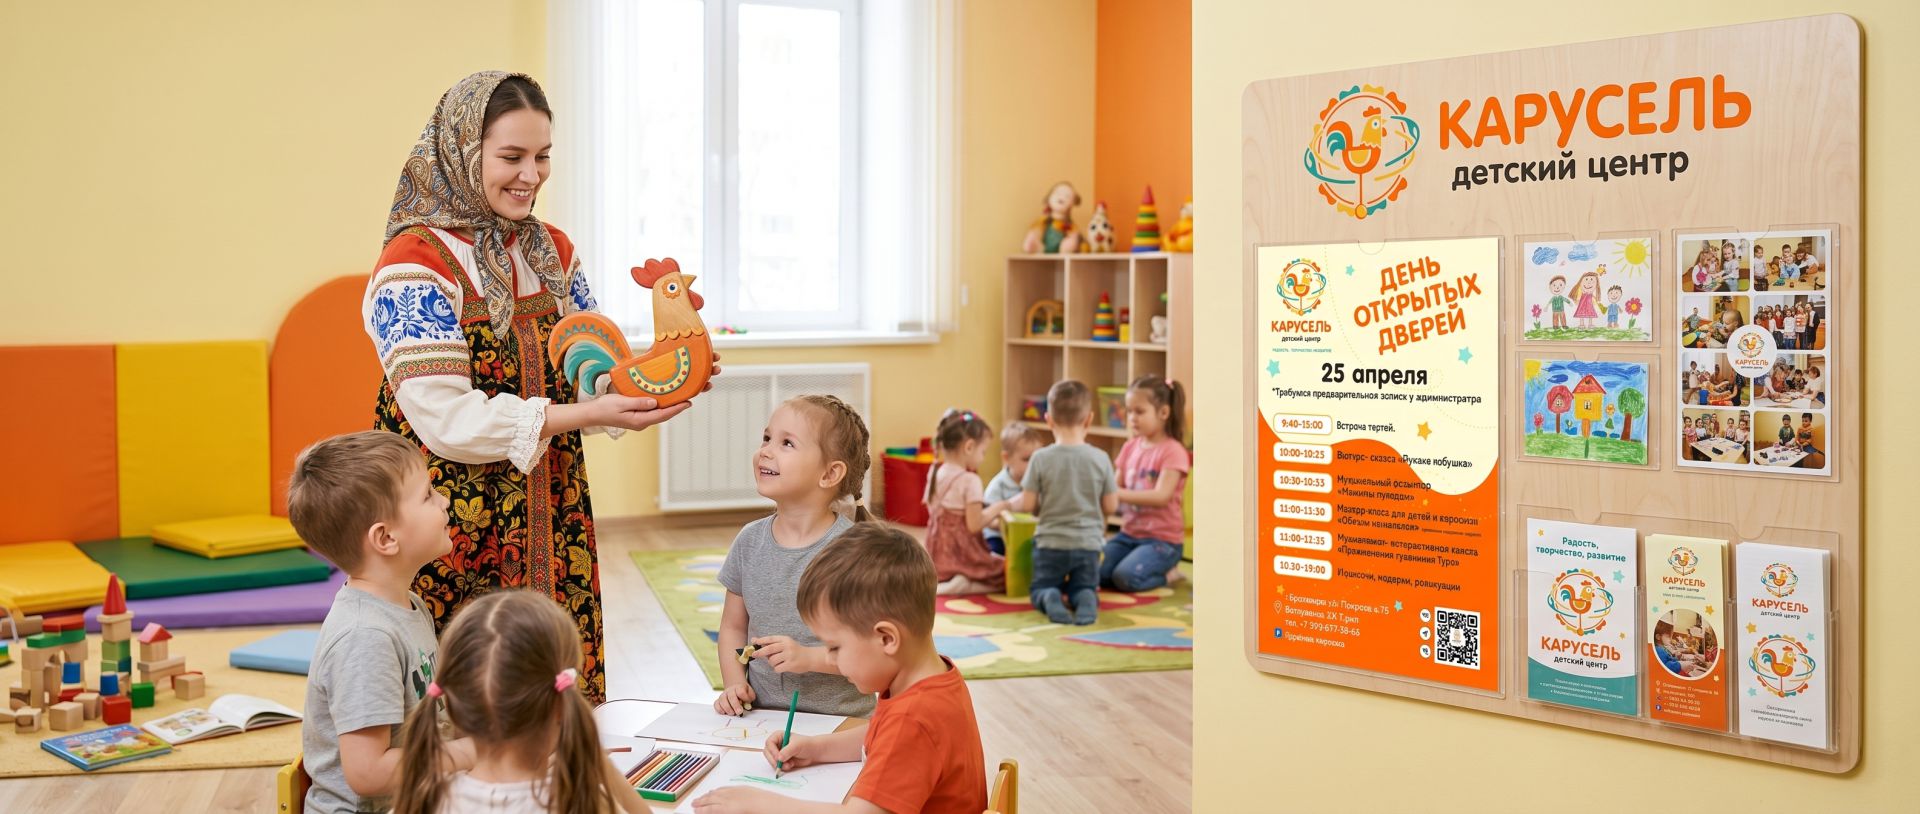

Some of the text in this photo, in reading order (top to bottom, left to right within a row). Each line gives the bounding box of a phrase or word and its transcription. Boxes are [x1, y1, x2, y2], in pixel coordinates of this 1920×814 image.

[1439, 74, 1752, 150] КАРУСЕЛЬ
[1452, 150, 1690, 191] детский центр
[1379, 255, 1441, 295] ДЕНЬ
[1353, 272, 1482, 328] ОТКРЫТЫХ
[1271, 320, 1332, 333] КАРУСЕЛЬ
[1378, 302, 1466, 355] ДВЕРЕЙ
[1321, 363, 1428, 389] 25 апреля
[1281, 419, 1324, 430] 9:40-15:00
[1279, 448, 1325, 459] 10:00-10:25
[1562, 536, 1599, 550] Радость,
[1535, 546, 1627, 563] творчество, развитие
[1662, 576, 1706, 588] КАРУСЕЛЬ
[1752, 598, 1809, 614] КАРУСЕЛЬ
[1541, 636, 1621, 661] КАРУСЕЛЬ
[1553, 656, 1608, 670] детский центр
